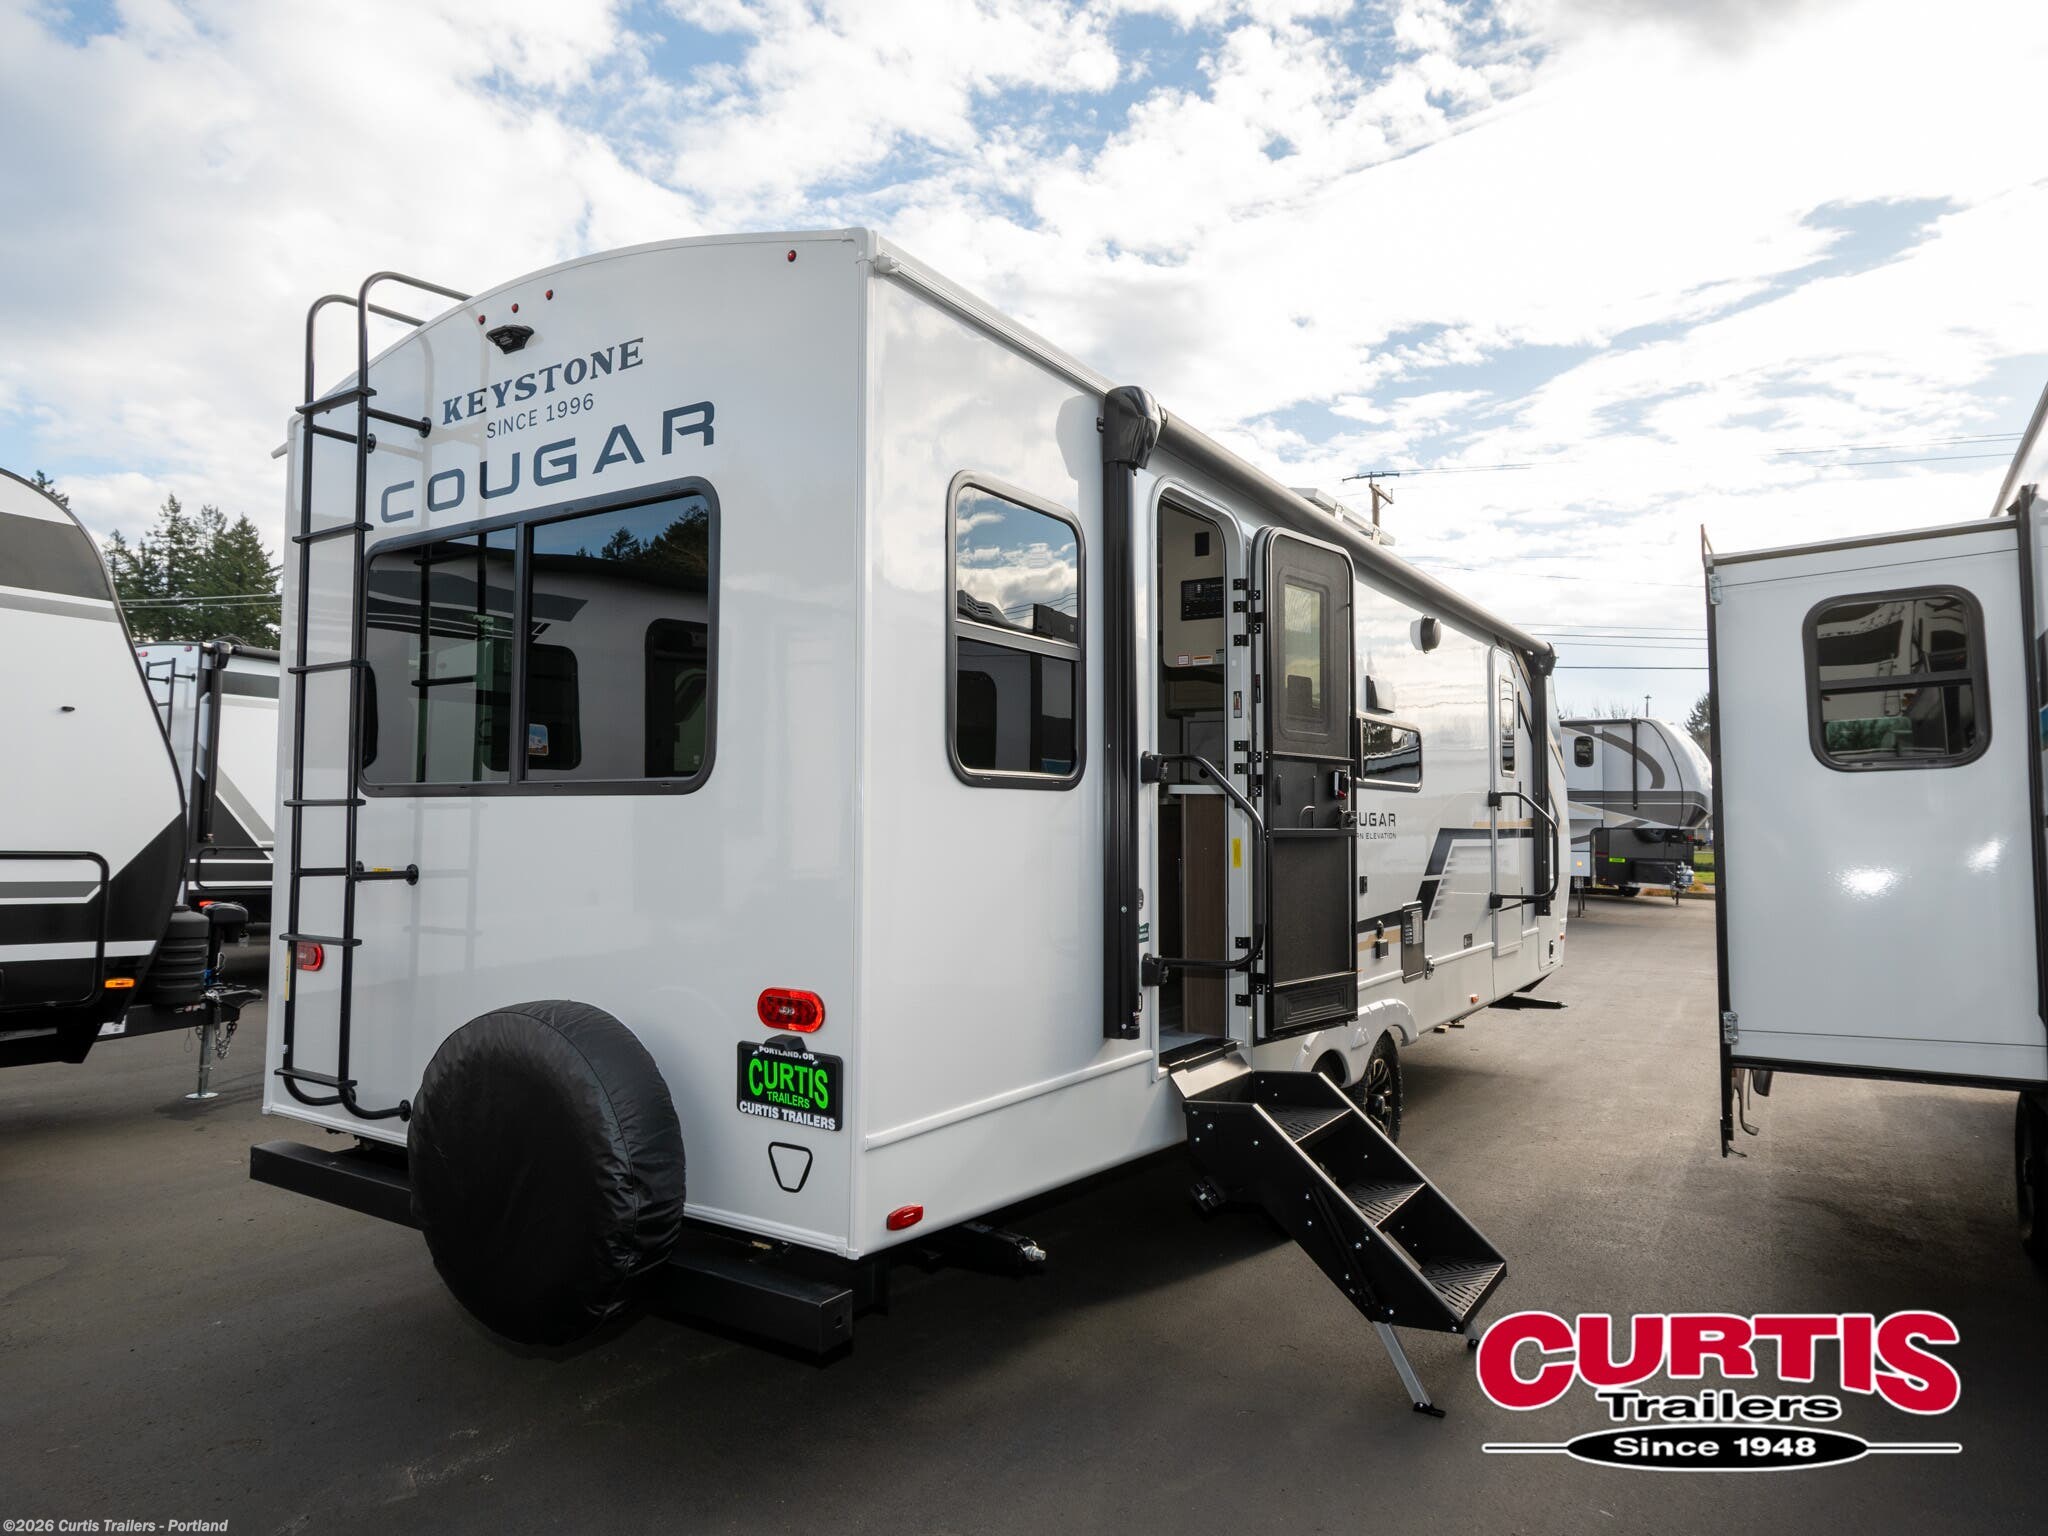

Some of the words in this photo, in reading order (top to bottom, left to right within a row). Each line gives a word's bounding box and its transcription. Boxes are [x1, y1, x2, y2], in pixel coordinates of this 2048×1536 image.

[442, 337, 644, 425] KEYSTONE
[486, 408, 538, 439] SINCE
[545, 392, 595, 423] 1996
[380, 400, 716, 524] COUGAR
[1358, 811, 1397, 827] UGAR
[802, 1052, 815, 1061] OR
[748, 1058, 829, 1109] CURTIS
[767, 1091, 811, 1109] TRAILERS
[739, 1100, 780, 1119] CURTIS
[781, 1108, 836, 1131] TRAILERS
